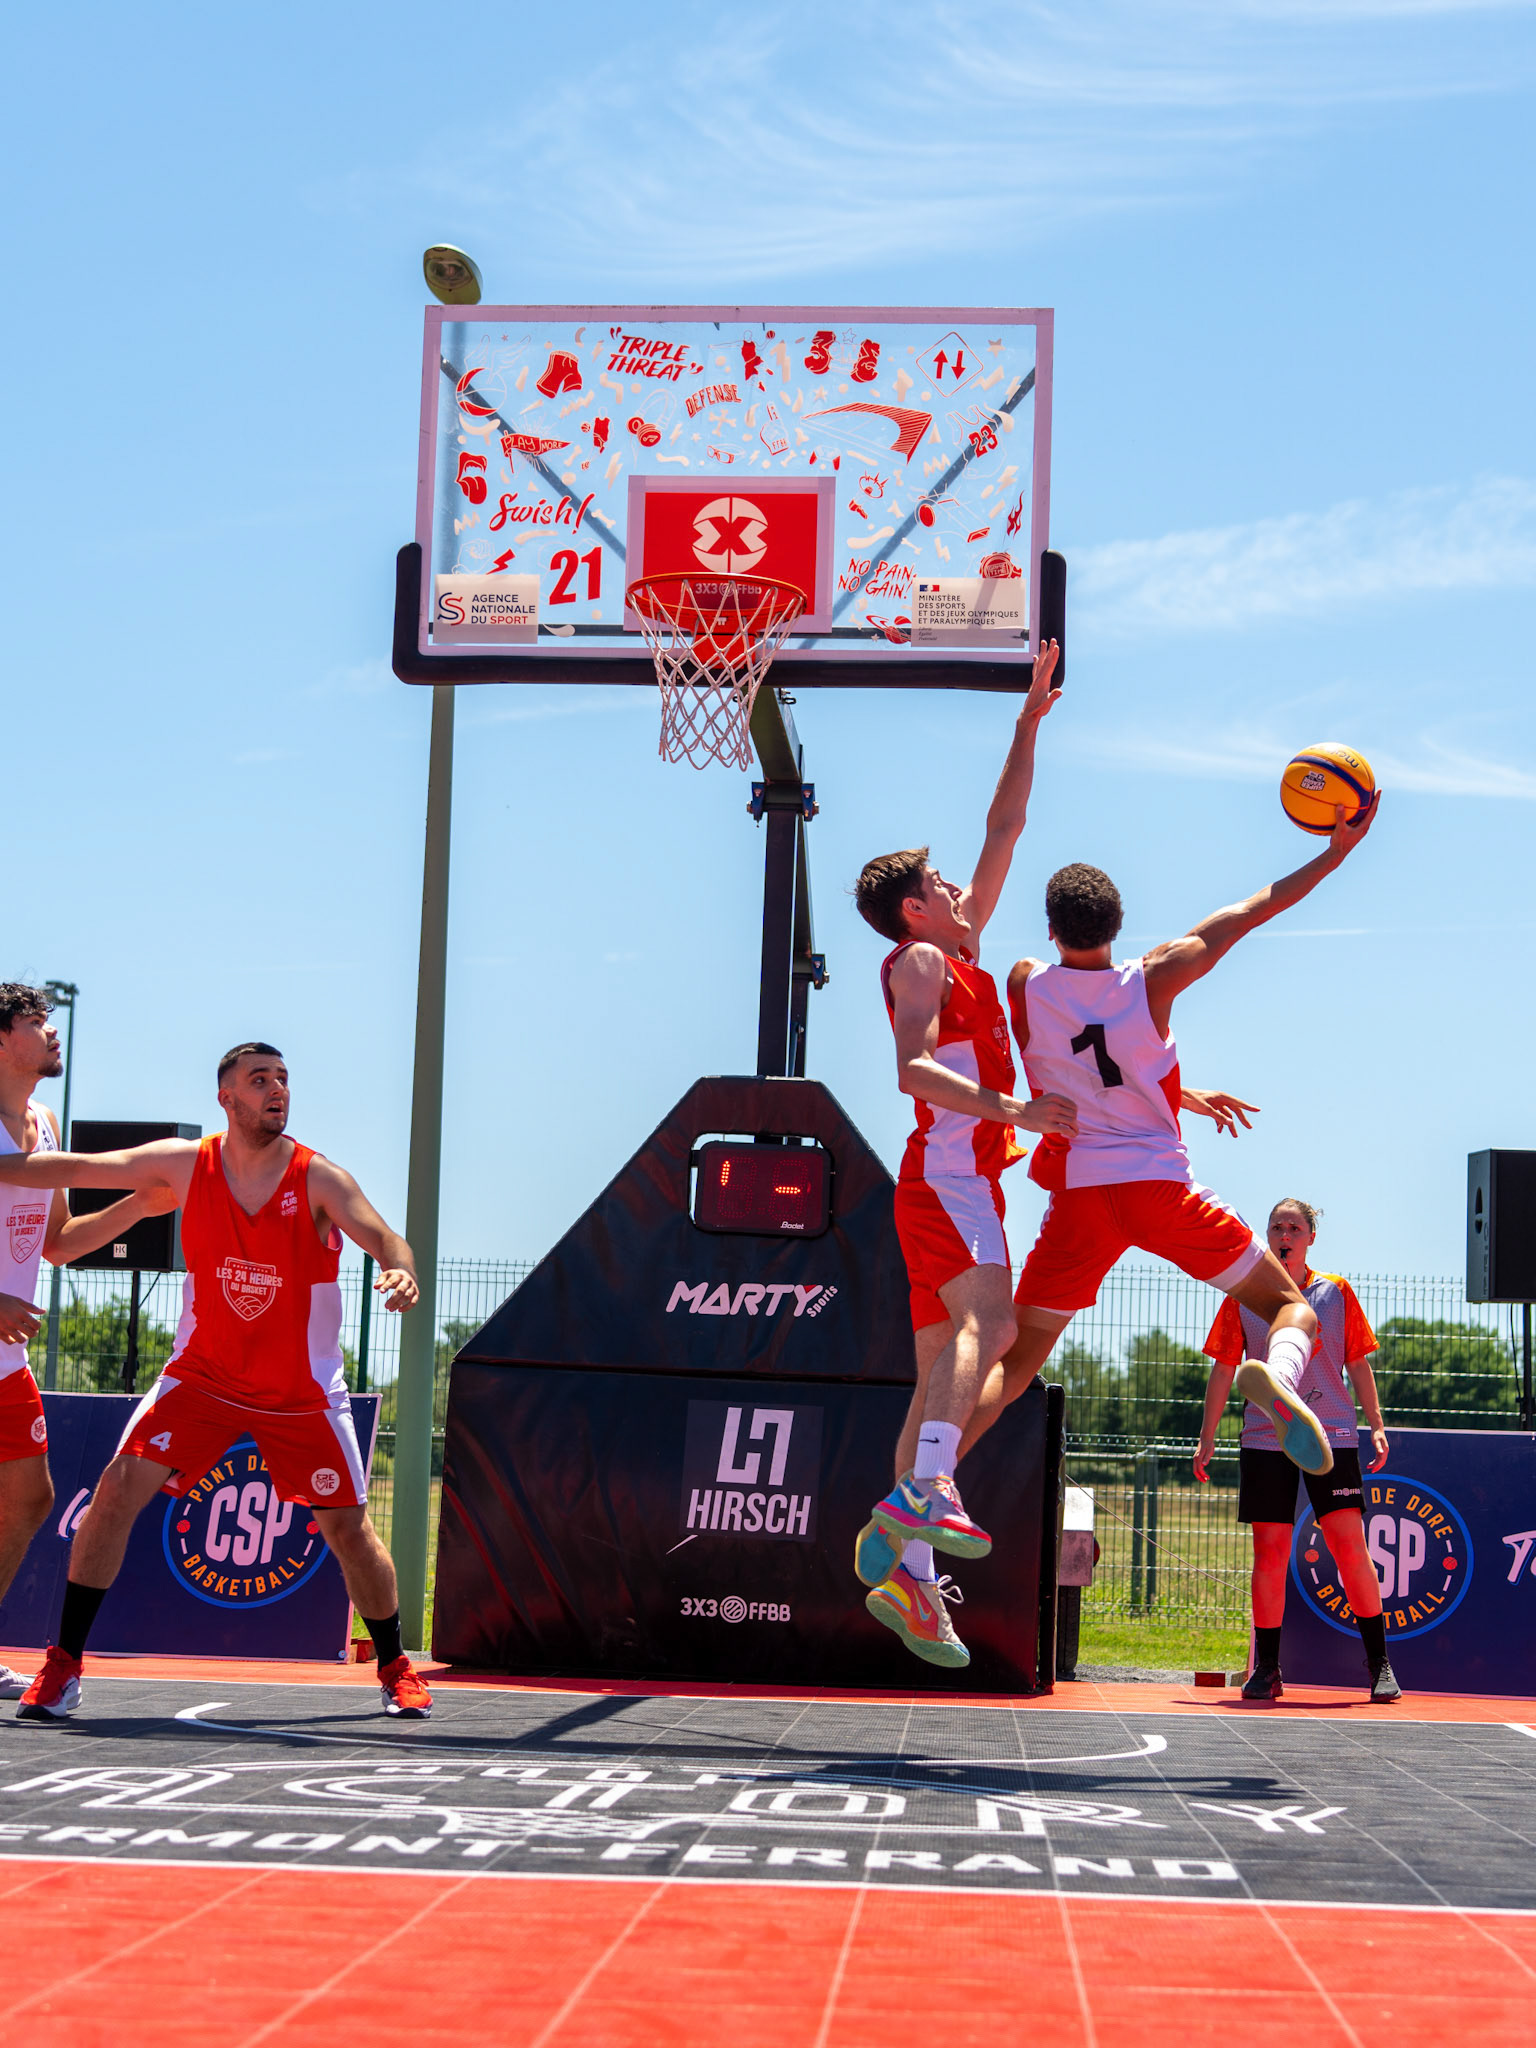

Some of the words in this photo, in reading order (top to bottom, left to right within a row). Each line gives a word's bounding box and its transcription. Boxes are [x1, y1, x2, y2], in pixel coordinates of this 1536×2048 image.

[685, 384, 742, 419] DEFENSE
[503, 436, 536, 451] PLAY
[541, 441, 563, 453] MORE
[968, 424, 998, 458] 23
[489, 493, 595, 535] Swish!
[549, 546, 602, 606] 21
[847, 556, 871, 576] NO
[472, 594, 519, 603] AGENCE
[695, 583, 718, 594] 3X3
[837, 573, 861, 592] NO
[865, 579, 913, 600] GAIN!
[918, 594, 961, 602] MINISTÈRE
[471, 605, 536, 614] NATIONALE
[471, 616, 487, 625] DU
[490, 616, 529, 625] SPORT
[930, 618, 996, 626] PARALYMPIQUES
[1070, 1023, 1124, 1088] 1
[6, 1216, 16, 1227] LES
[216, 1266, 233, 1280] LES
[234, 1269, 247, 1282] 24
[249, 1271, 283, 1288] HEURES
[230, 1281, 240, 1291] DU
[241, 1283, 268, 1296] BASKET
[666, 1280, 824, 1318] MARTY
[806, 1285, 838, 1318] Sports
[150, 1431, 172, 1452] 4
[188, 1460, 235, 1503] PONT
[205, 1481, 294, 1566] CSP
[686, 1489, 812, 1536] HIRSCH
[1371, 1487, 1396, 1505] DE
[1405, 1494, 1453, 1540] DORE
[1338, 1514, 1426, 1600] SP
[183, 1554, 305, 1597] BASKETBALL
[680, 1597, 718, 1618] 3X3
[749, 1601, 791, 1622] FFBB
[1316, 1584, 1446, 1630] BASTBALL
[0, 1766, 1348, 1834] ACTORY
